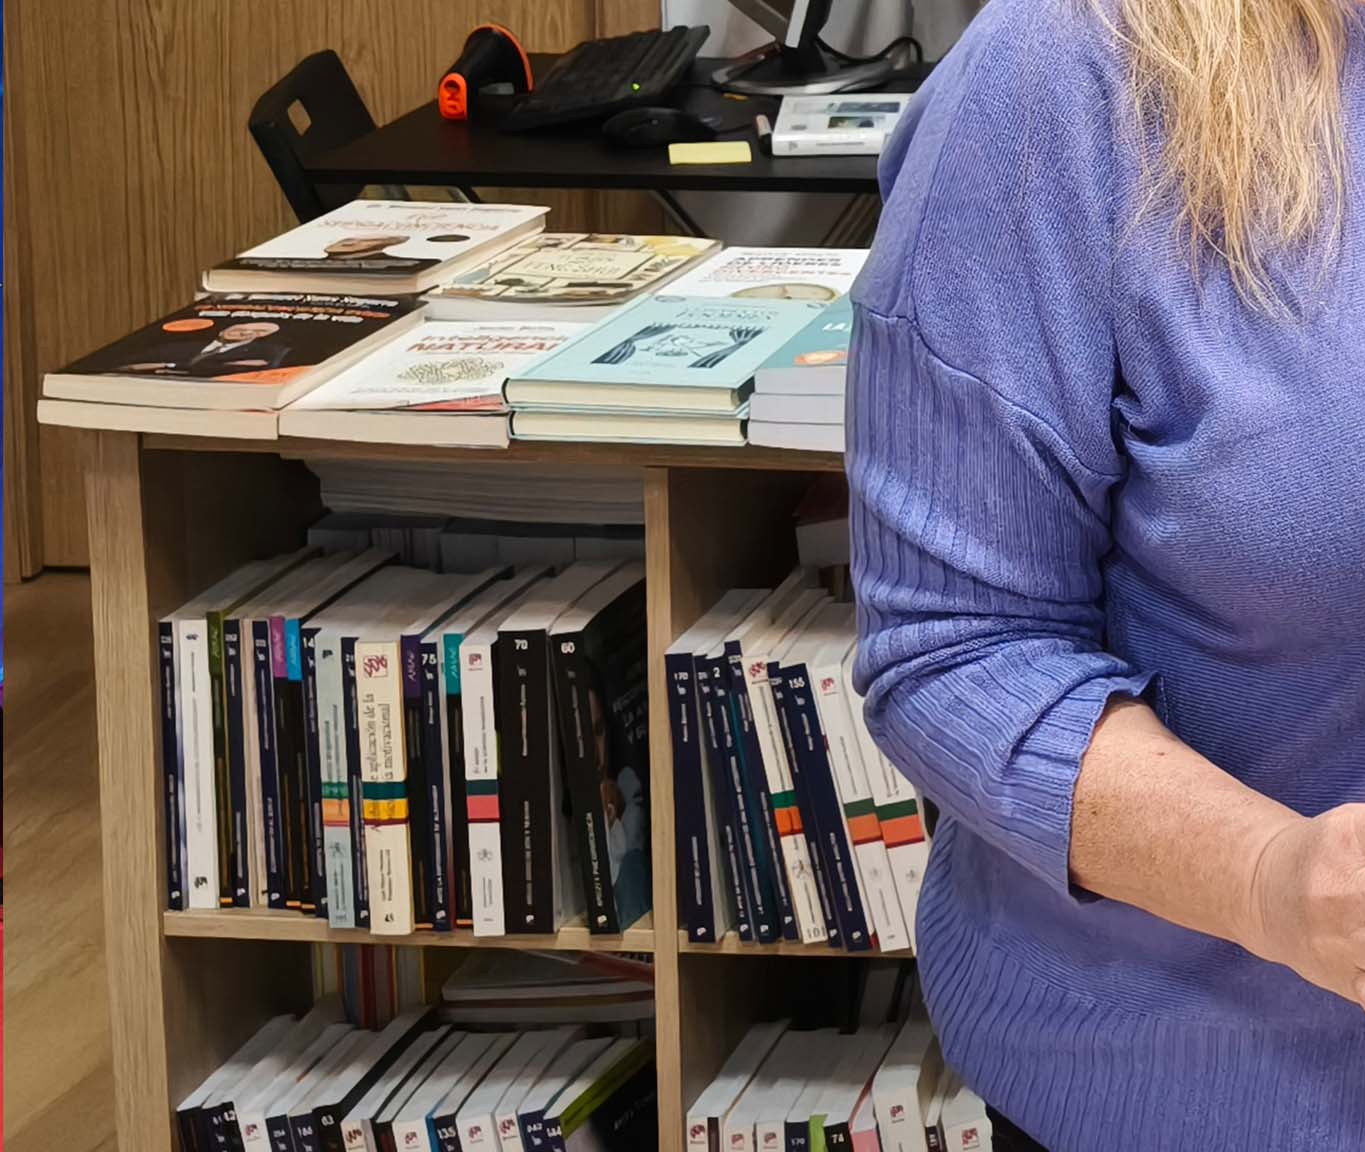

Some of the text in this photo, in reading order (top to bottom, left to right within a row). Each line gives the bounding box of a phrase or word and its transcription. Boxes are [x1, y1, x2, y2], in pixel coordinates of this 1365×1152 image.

[514, 639, 528, 650] 70
[421, 653, 436, 665] 75
[713, 667, 721, 679] 2
